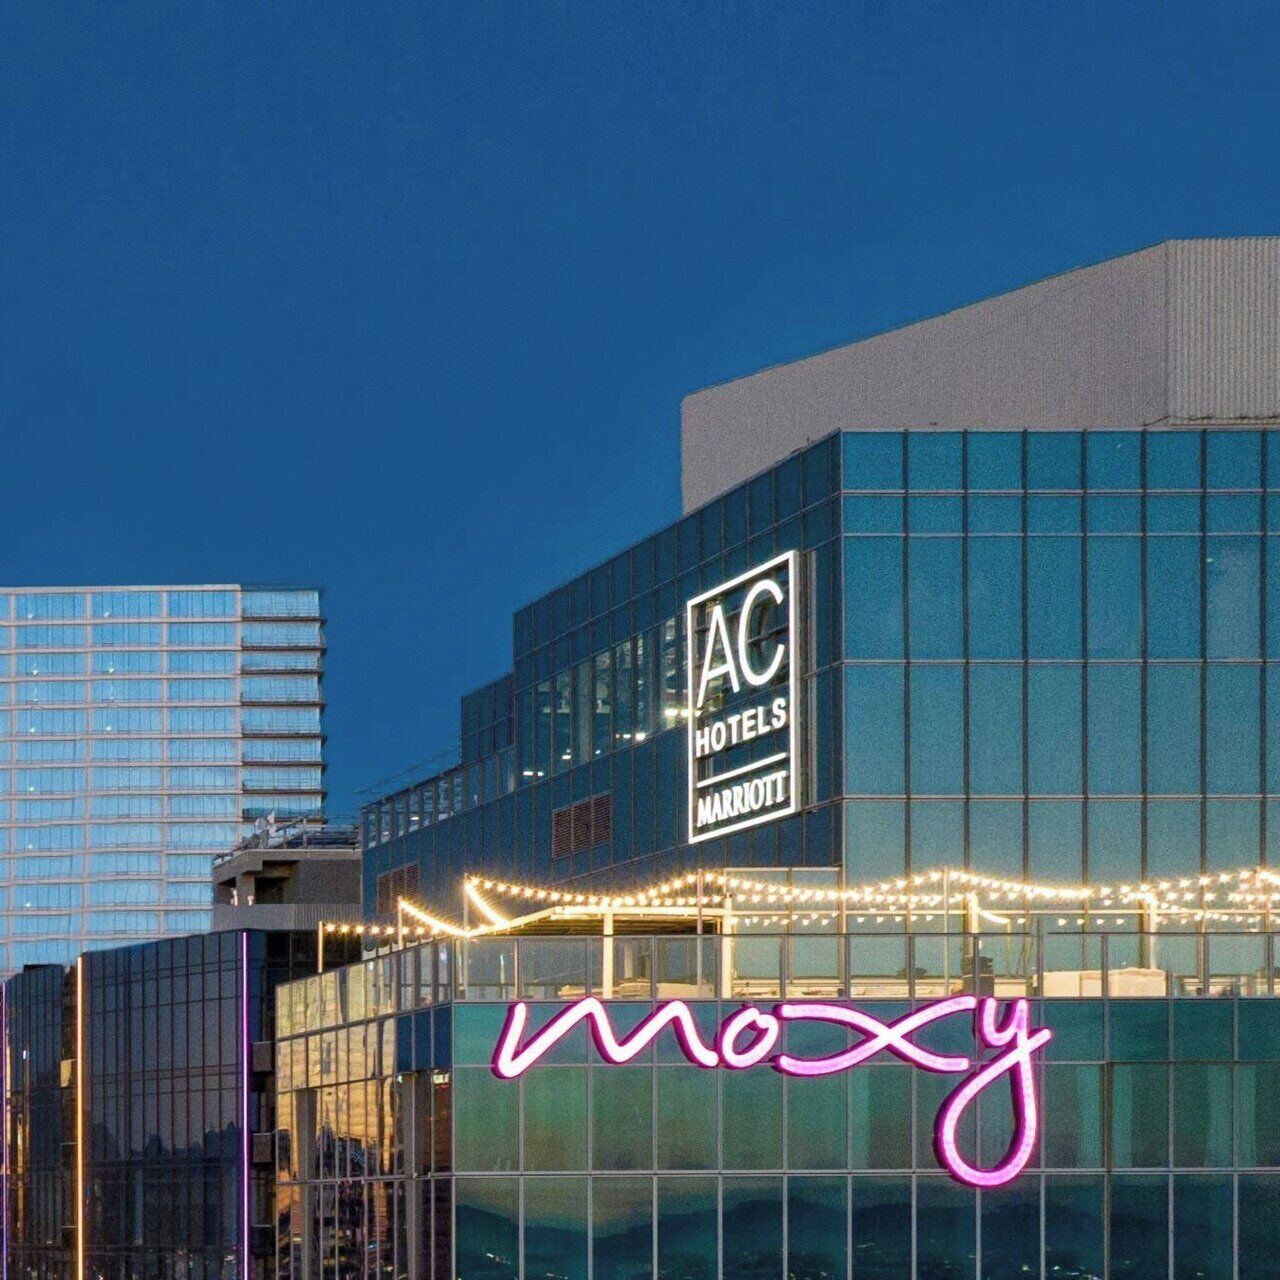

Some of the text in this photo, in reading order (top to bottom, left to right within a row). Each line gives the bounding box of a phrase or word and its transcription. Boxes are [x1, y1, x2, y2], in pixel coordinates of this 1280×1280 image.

[697, 579, 785, 709] AC
[696, 697, 787, 758] HOTELS
[697, 769, 788, 827] MARRIOTT
